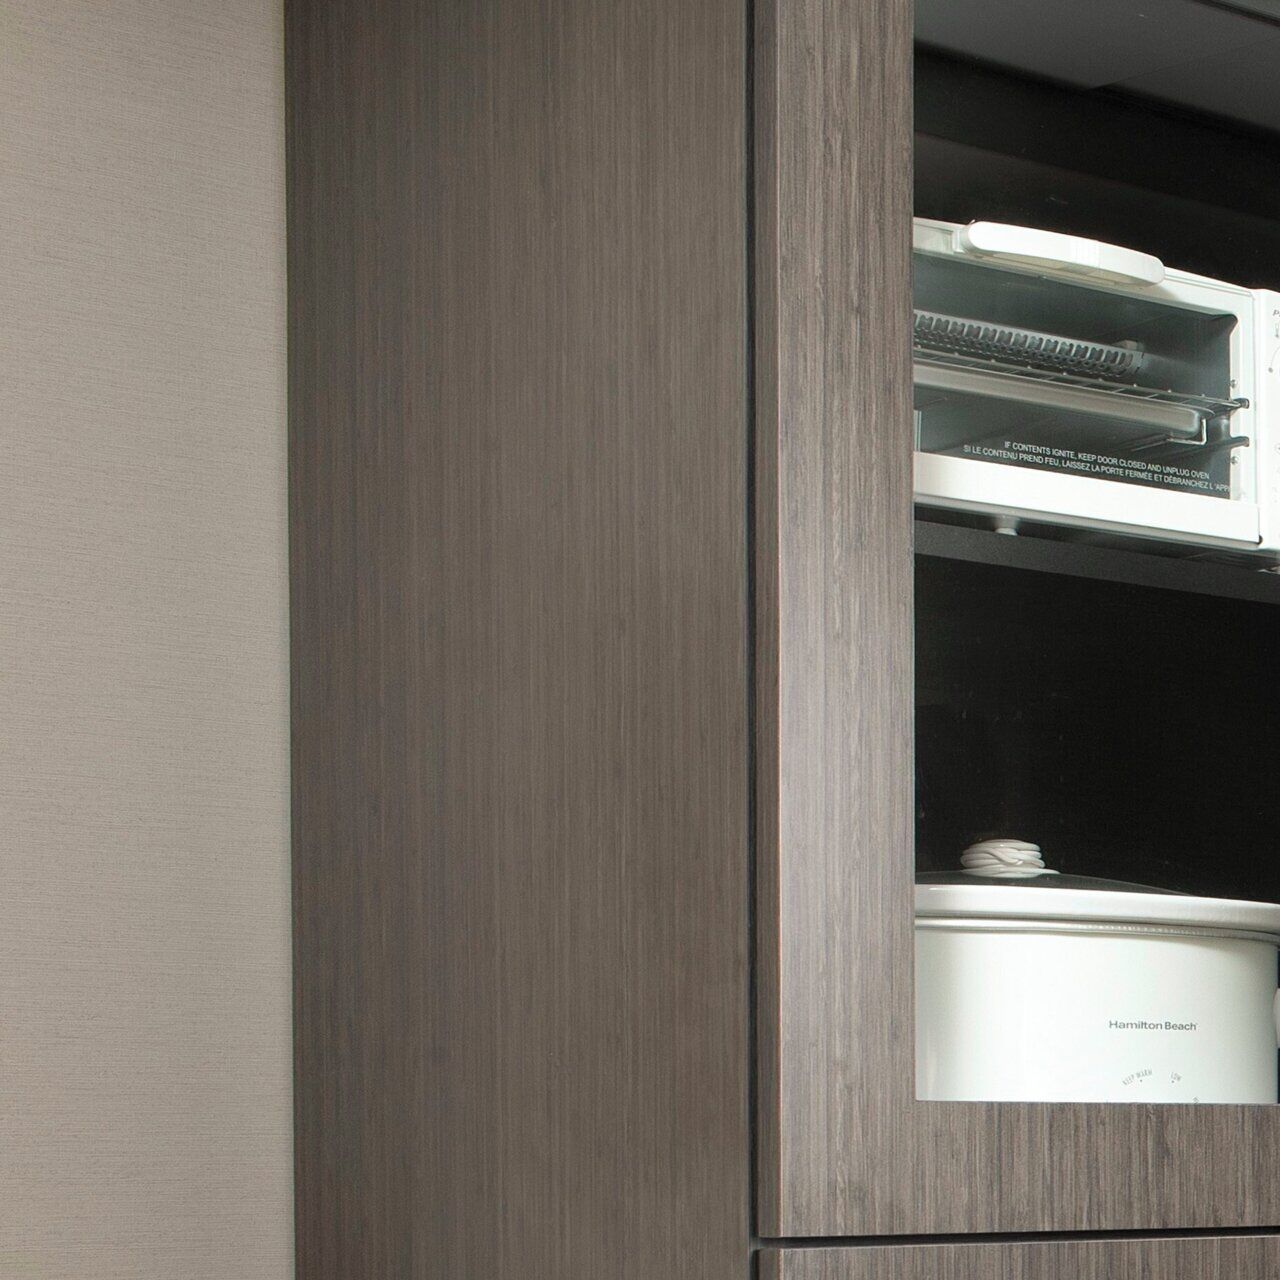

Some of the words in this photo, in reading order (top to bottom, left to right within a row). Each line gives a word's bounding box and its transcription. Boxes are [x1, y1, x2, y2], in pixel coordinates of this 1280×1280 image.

[963, 444, 971, 453] SI
[972, 446, 981, 455] LE
[982, 447, 1018, 460] CONTENU
[1019, 453, 1043, 464] PREND
[1062, 460, 1091, 471] LAISSEZ
[1091, 464, 1102, 473] LA
[1102, 465, 1124, 477] PORTE
[1125, 469, 1153, 481] FERMÉE
[1154, 474, 1163, 482] ET
[1164, 474, 1208, 490] DÉBRANCHEZ
[1004, 441, 1011, 449] IF
[1013, 442, 1051, 456] CONTENTS
[1052, 449, 1077, 460] IGNITE,
[1078, 453, 1096, 462] KEEP
[1098, 455, 1118, 466] DOOR
[1120, 458, 1146, 470] CLOSED
[1147, 464, 1162, 472] AND
[1163, 466, 1190, 477] UNPLUG
[1191, 470, 1210, 480] OVEN
[1109, 1020, 1162, 1030] Hamilton
[1164, 1021, 1197, 1031] Beach
